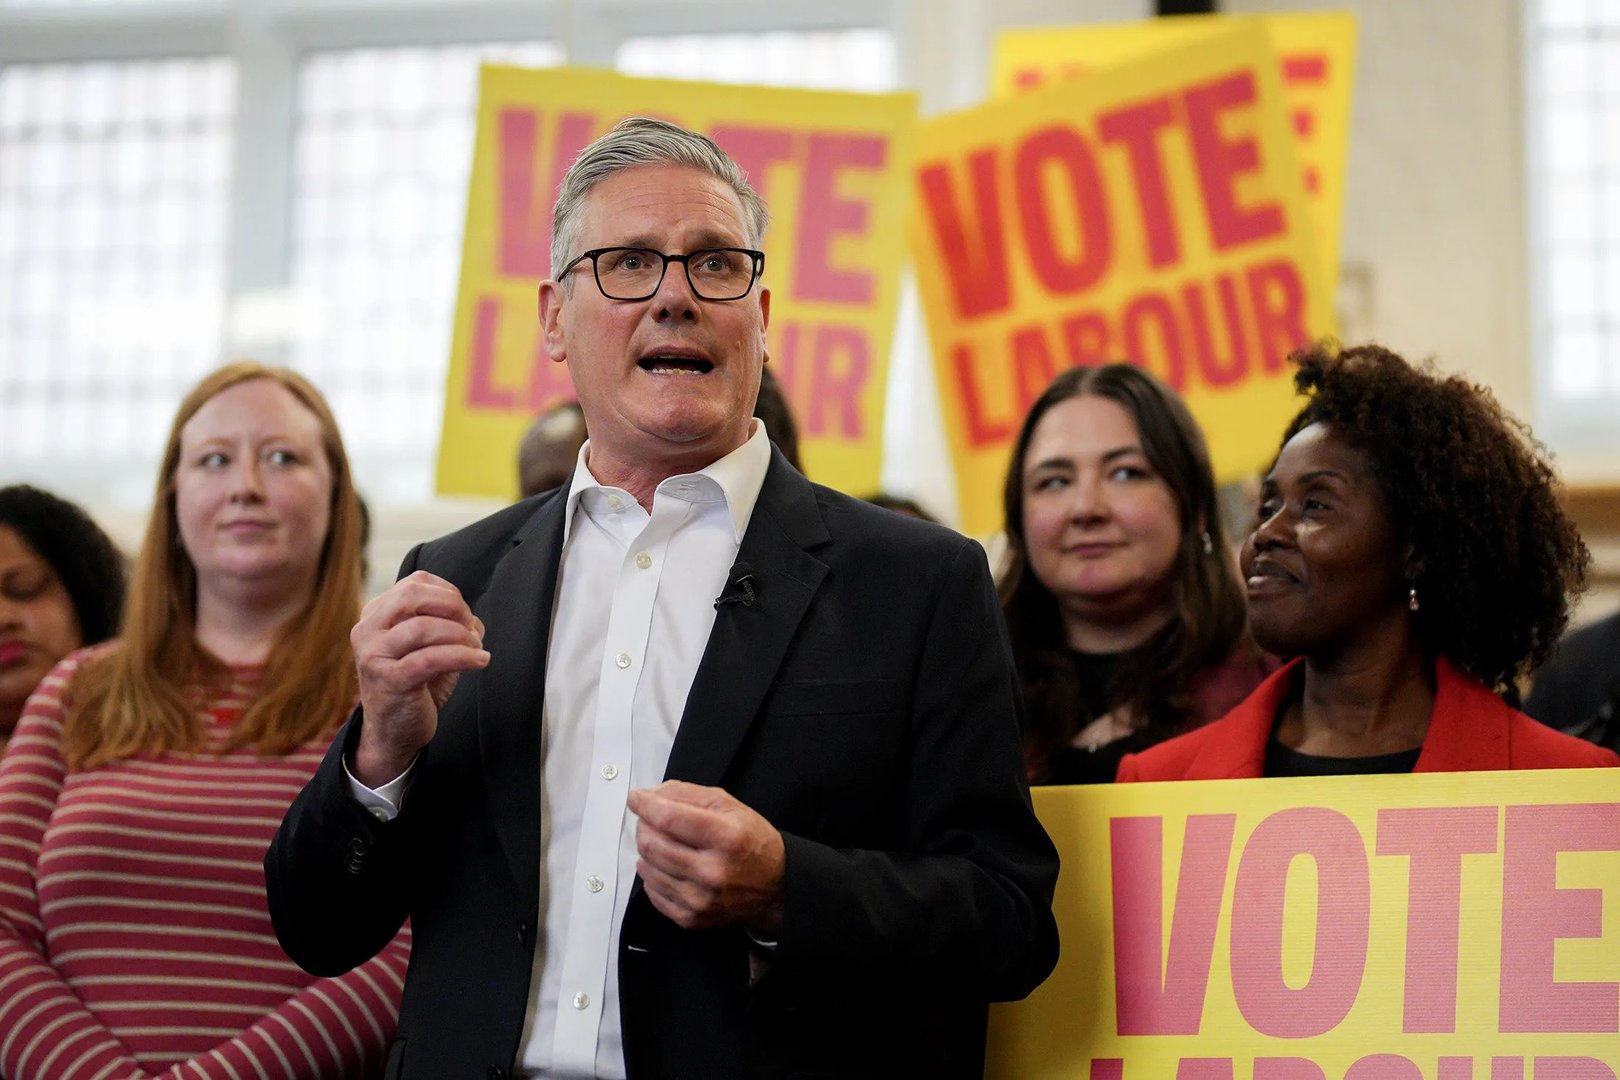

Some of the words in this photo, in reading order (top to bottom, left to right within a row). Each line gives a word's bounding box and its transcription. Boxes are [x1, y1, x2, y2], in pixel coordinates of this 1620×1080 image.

[496, 105, 887, 305] VTE
[917, 67, 1287, 320] VOTE
[1109, 802, 1620, 1039] VOTE
